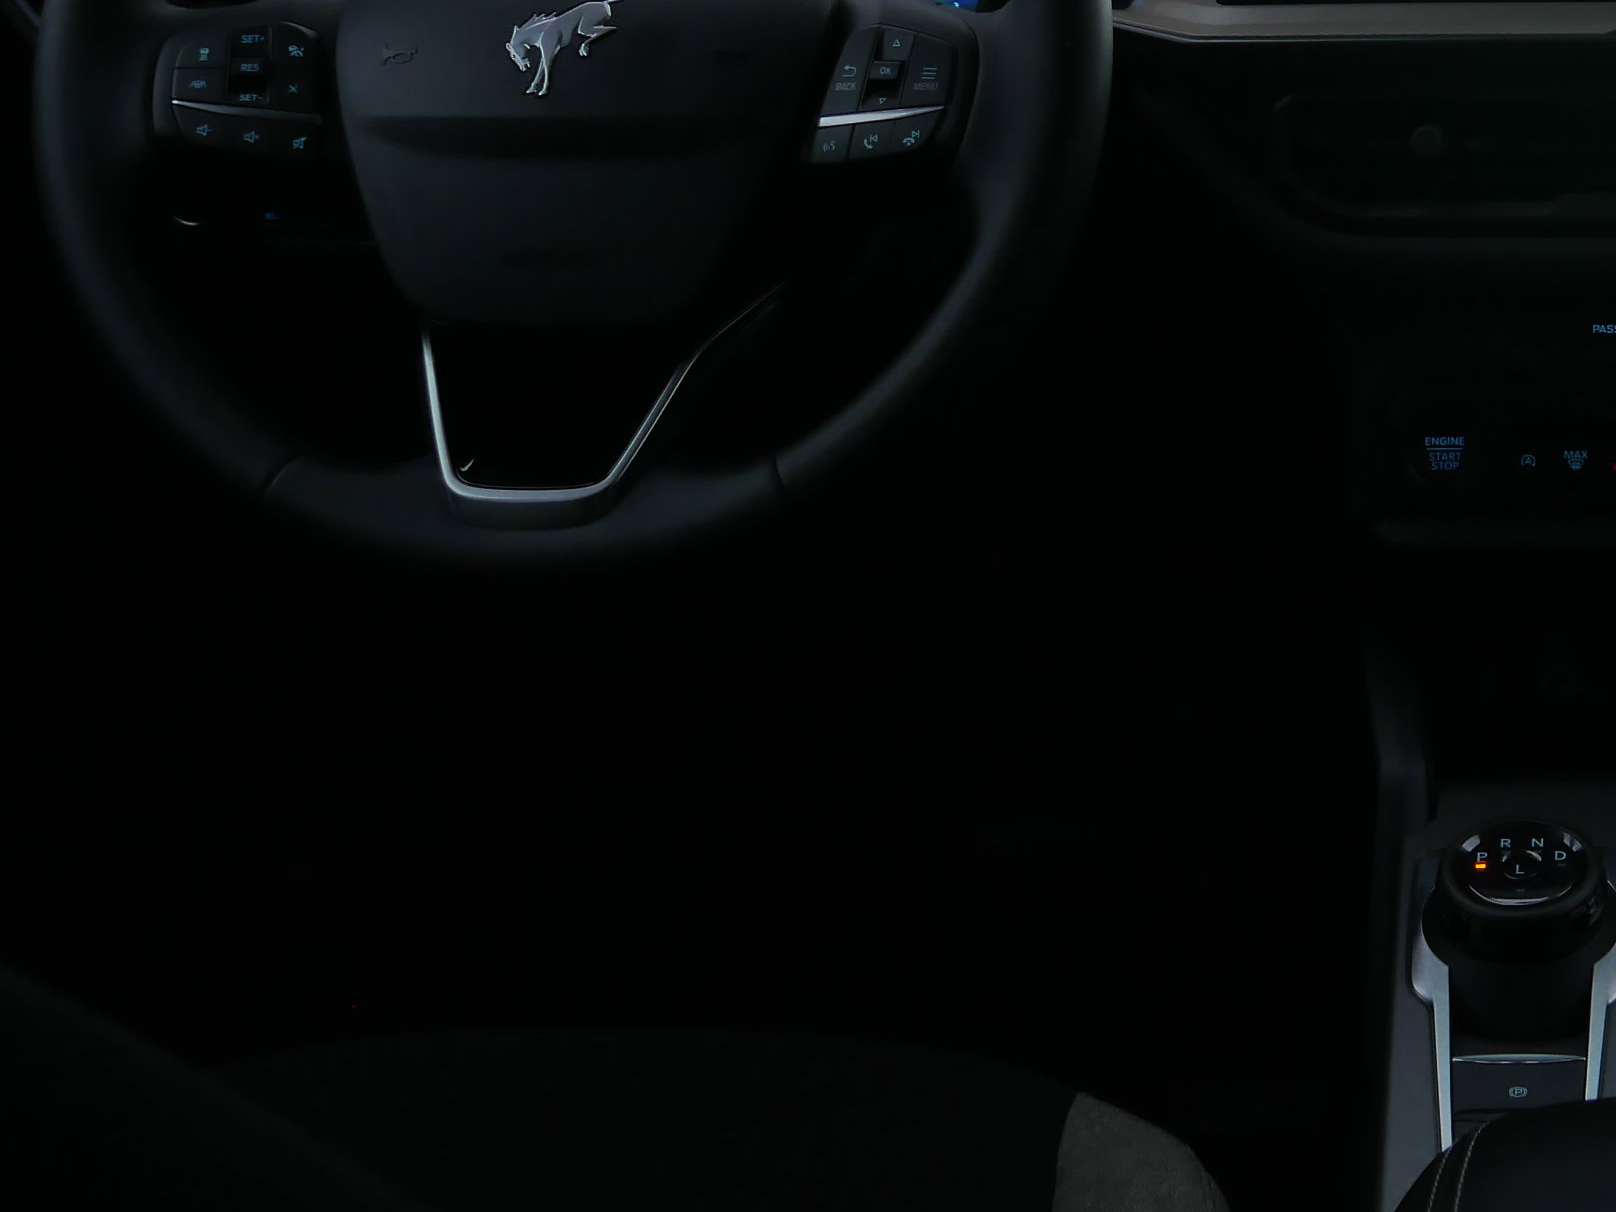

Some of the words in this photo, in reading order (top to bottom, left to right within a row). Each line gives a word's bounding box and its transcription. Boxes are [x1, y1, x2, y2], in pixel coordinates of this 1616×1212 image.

[240, 64, 260, 72] RES
[880, 66, 891, 75] OK
[835, 82, 856, 91] BACK
[1424, 436, 1465, 446] ENGINE
[1428, 452, 1462, 461] START
[1562, 450, 1588, 459] MAX
[1431, 461, 1460, 471] STOP
[1500, 838, 1512, 848] R
[1531, 838, 1544, 848] N
[1476, 852, 1488, 862] P
[1554, 850, 1567, 860] D
[1516, 864, 1525, 874] L
